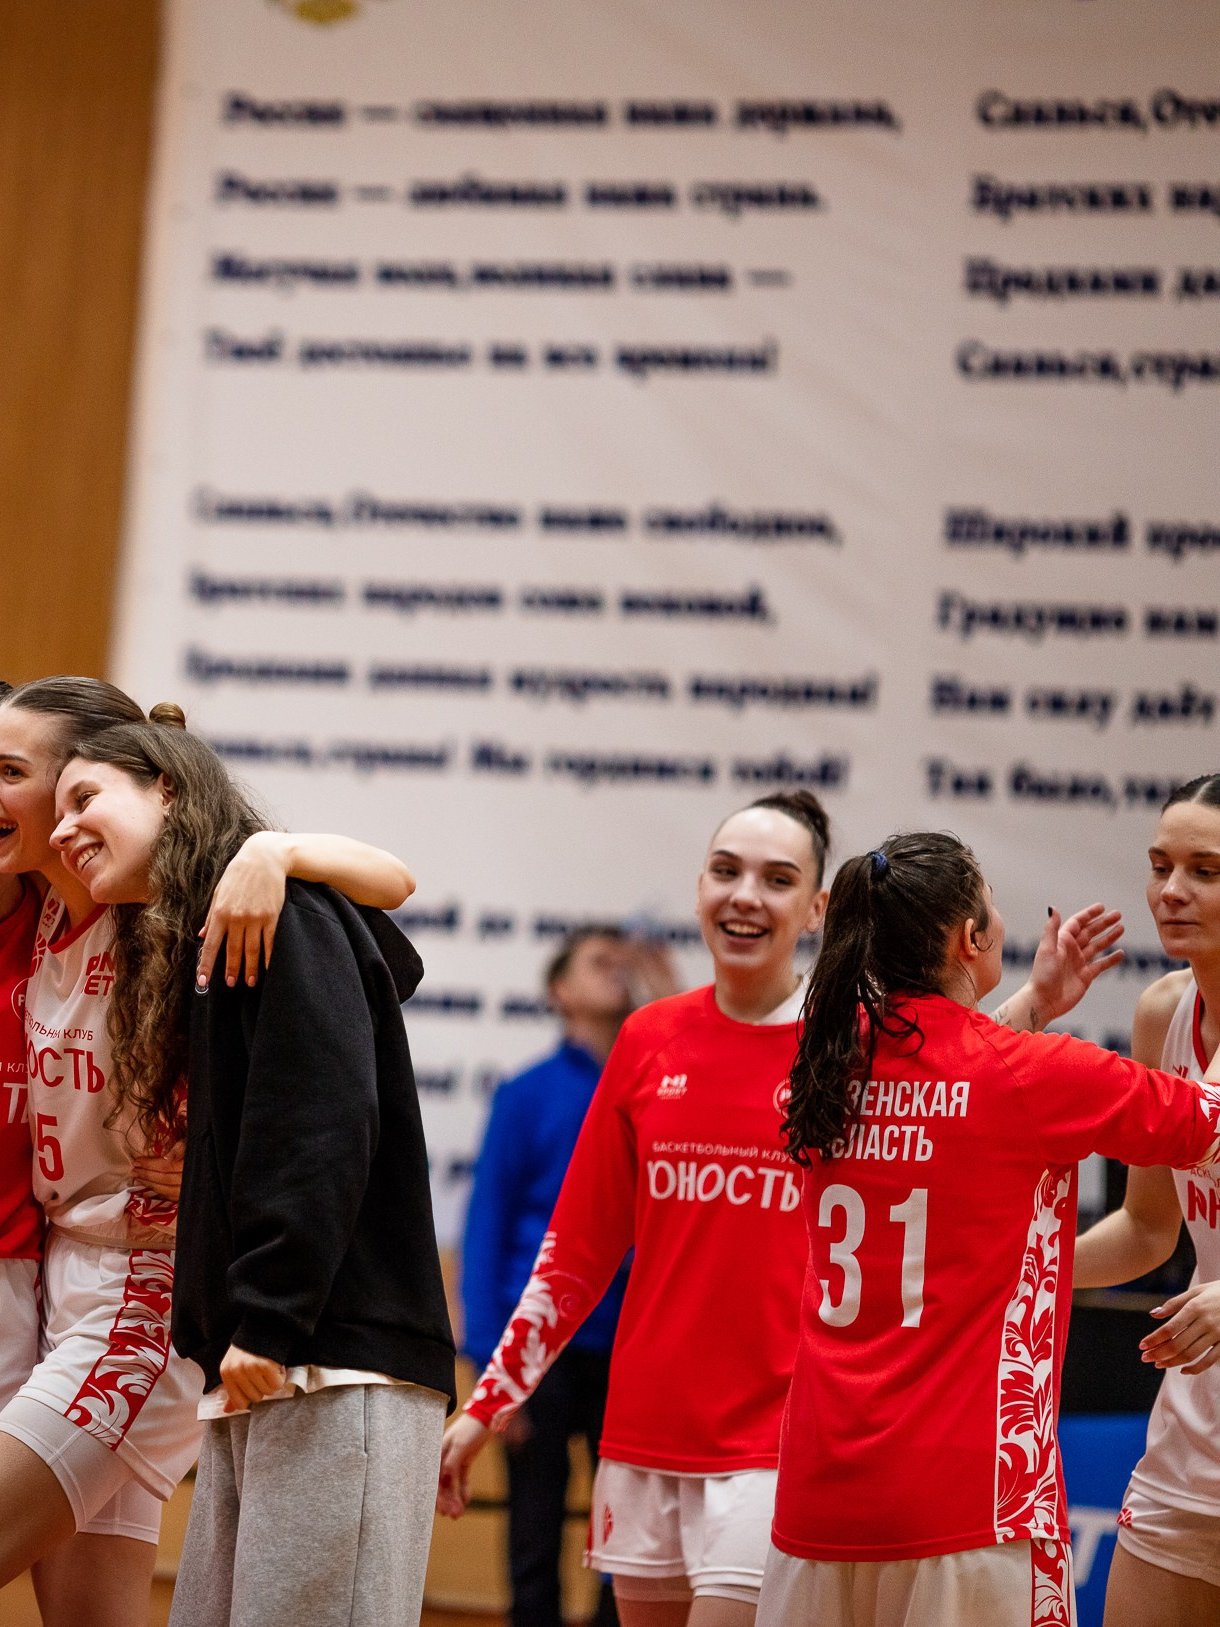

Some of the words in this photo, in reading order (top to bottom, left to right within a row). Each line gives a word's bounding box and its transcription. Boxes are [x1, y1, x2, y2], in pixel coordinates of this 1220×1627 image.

[63, 1028, 95, 1041] КЛУБ
[26, 1036, 105, 1094] ОСТЬ
[844, 1080, 971, 1118] ЗЕНСКАЯ
[36, 1112, 65, 1182] 5
[652, 1140, 759, 1159] БАСКЕТБОЛЬНЫЙ
[817, 1183, 929, 1328] 31
